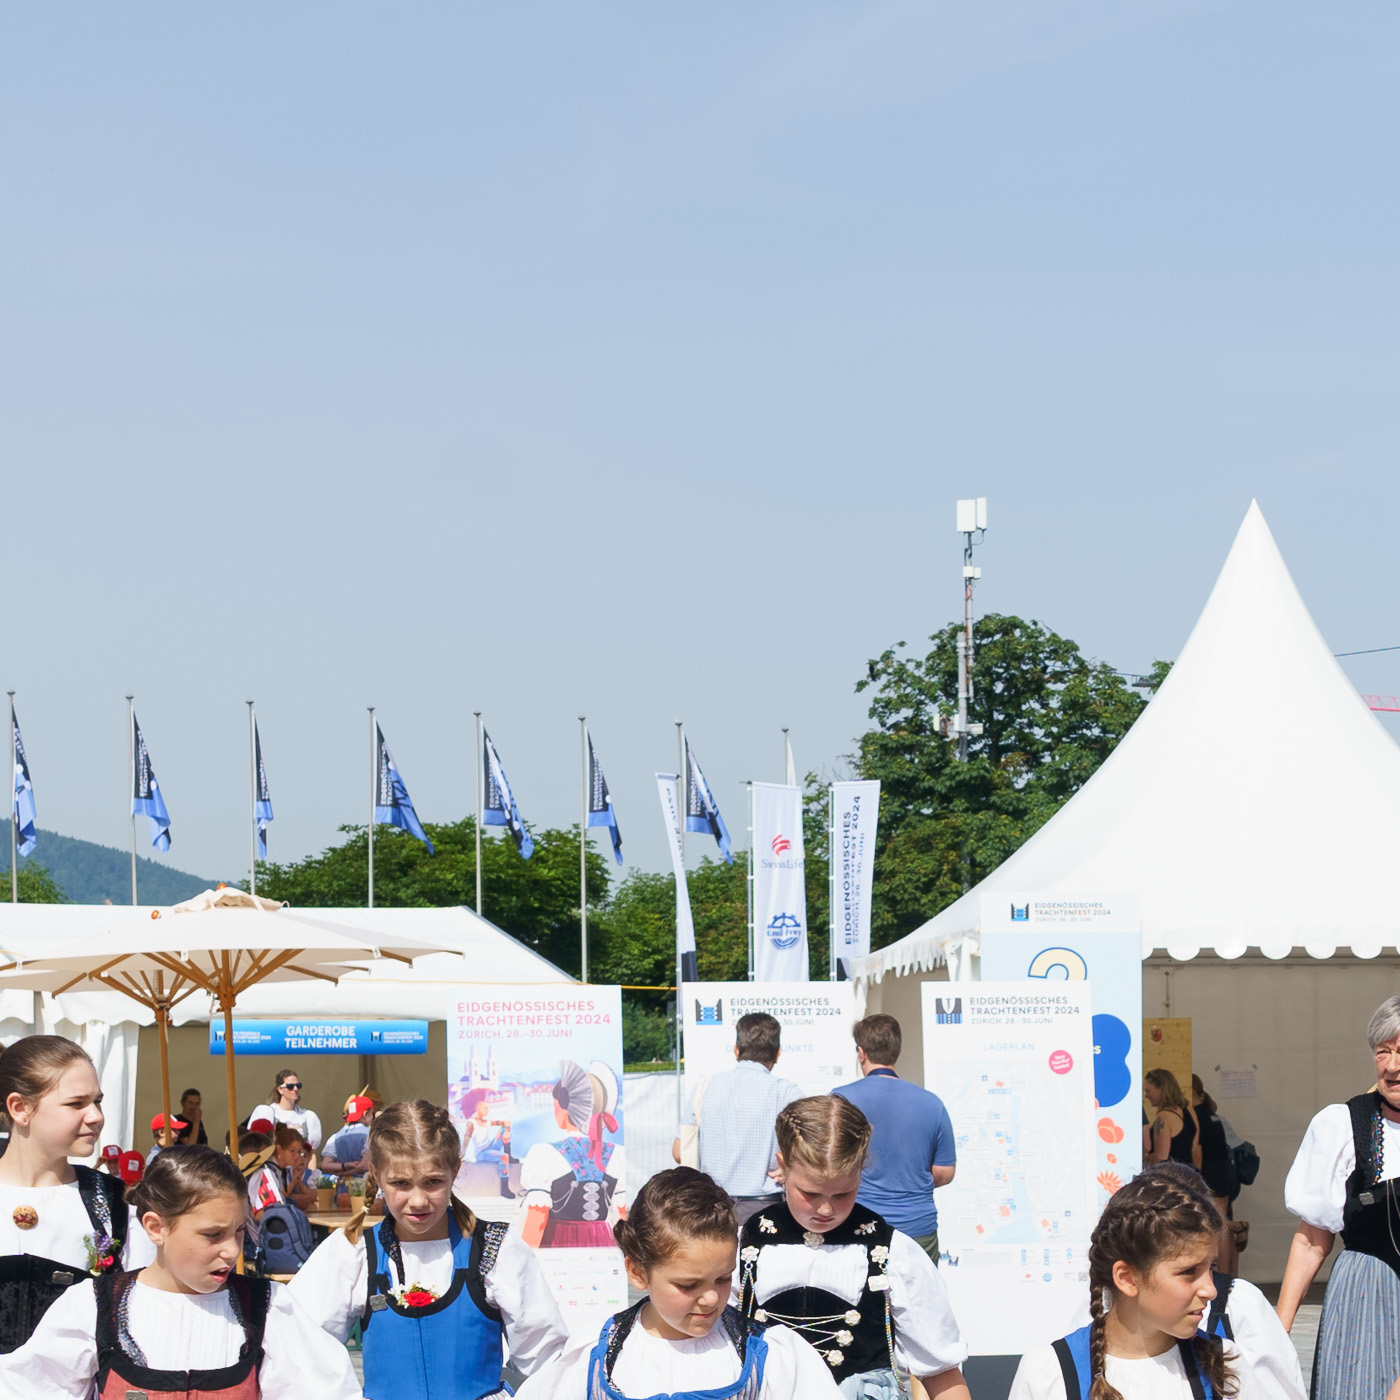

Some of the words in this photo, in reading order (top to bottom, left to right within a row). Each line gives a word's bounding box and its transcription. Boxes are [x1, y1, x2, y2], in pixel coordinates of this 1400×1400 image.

[730, 997, 830, 1006] EIDGENÖSSISCHES
[970, 996, 1068, 1005] EIDGENÖSSISCHES
[457, 1000, 595, 1013] EIDGENÖSSISCHES
[971, 1006, 1051, 1015] TRACHTENFEST
[1054, 1006, 1080, 1014] 2024
[816, 1007, 842, 1016] 2024
[458, 1015, 571, 1026] TRACHTENFEST
[575, 1014, 611, 1025] 2024
[286, 1025, 356, 1037] GARDEROBE
[284, 1037, 357, 1049] TEILNEHMER
[983, 1043, 1036, 1051] LAGEPLAN
